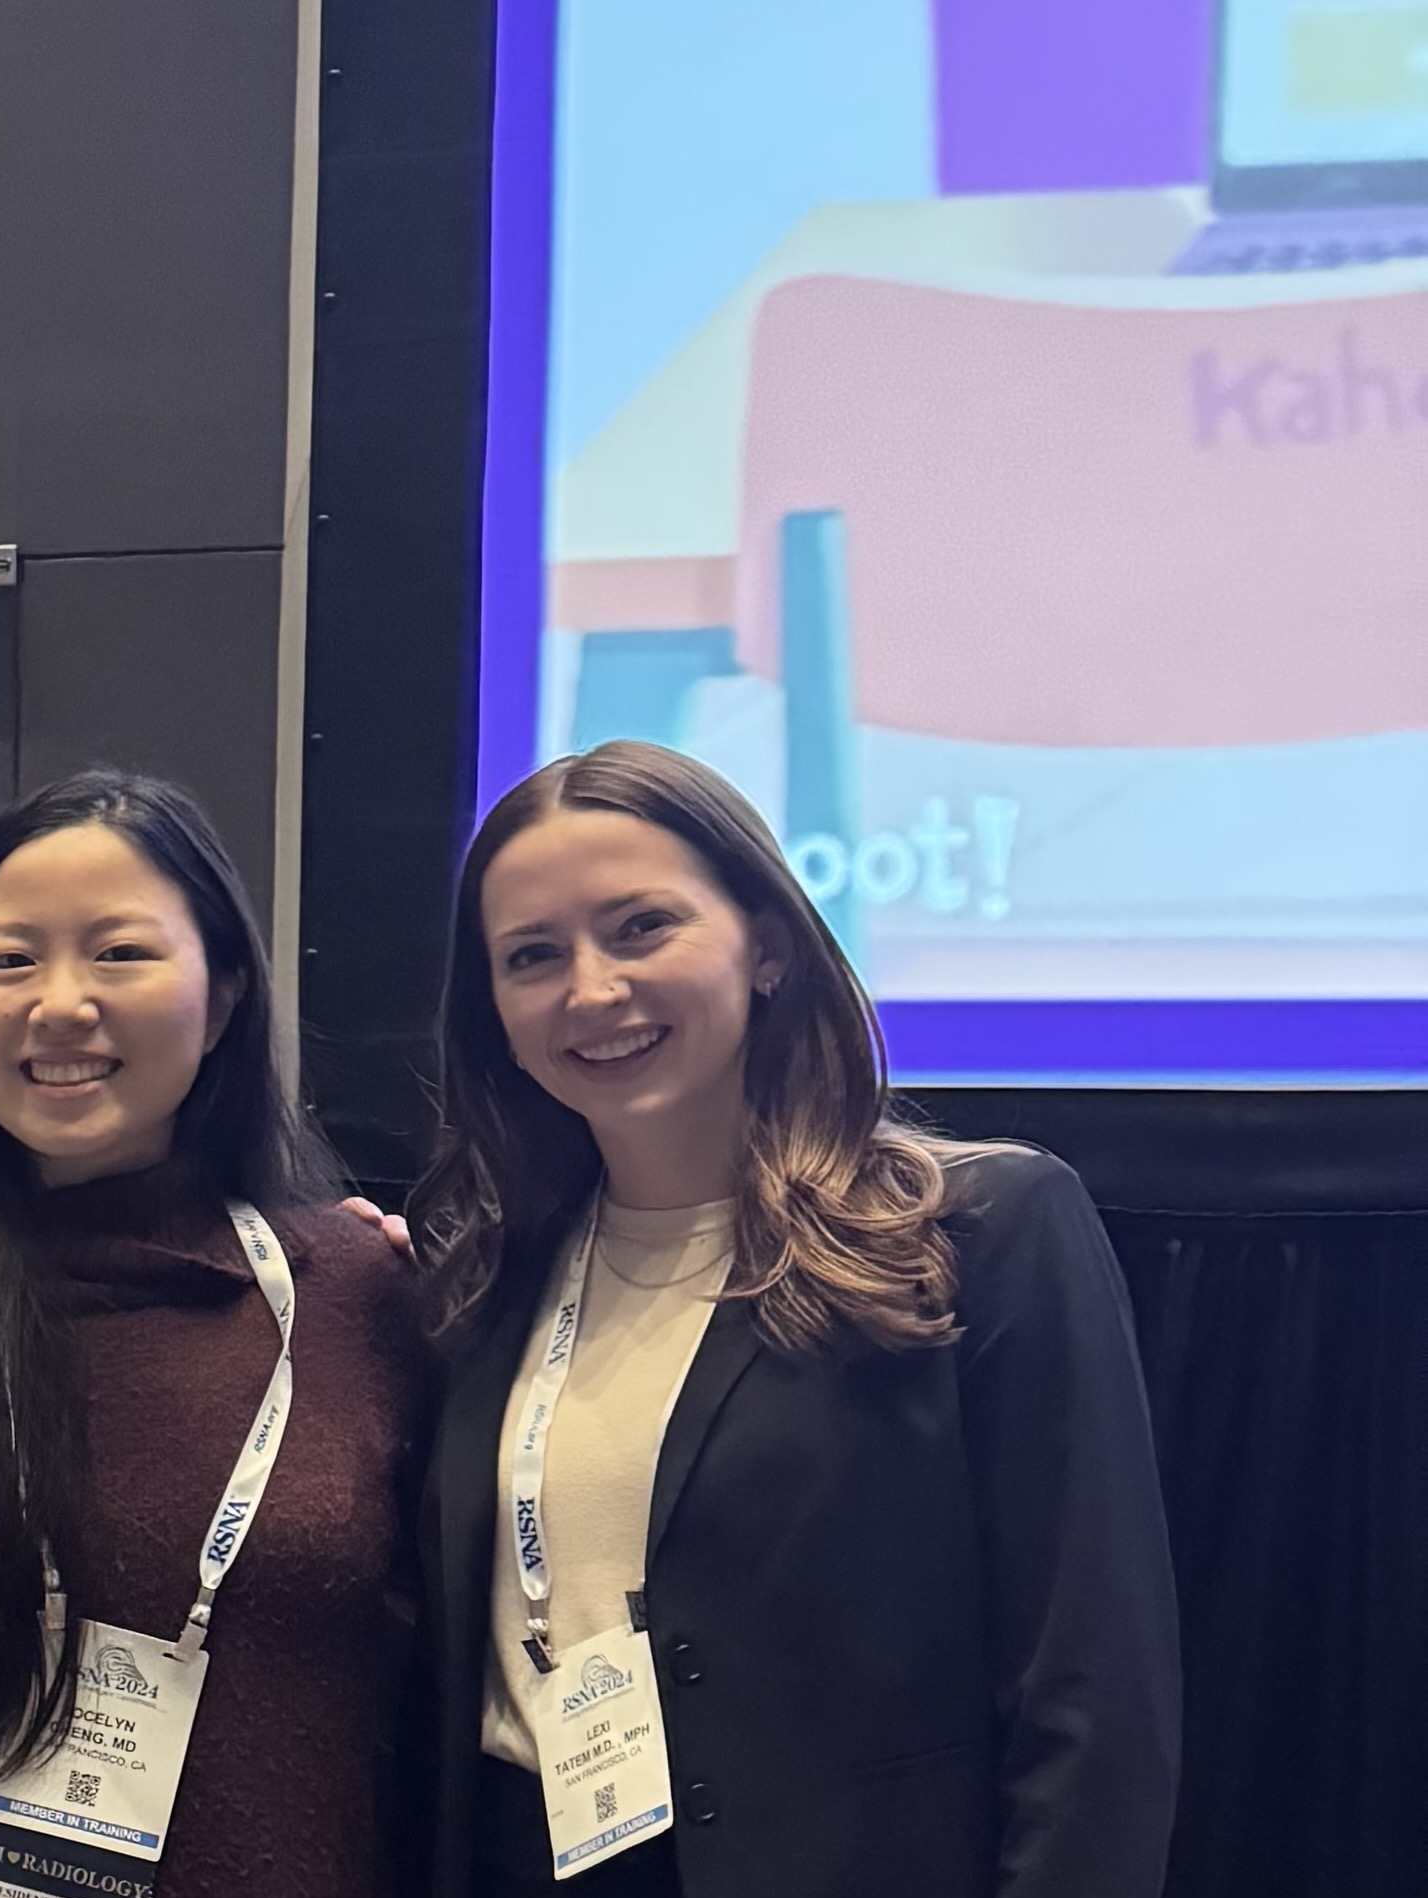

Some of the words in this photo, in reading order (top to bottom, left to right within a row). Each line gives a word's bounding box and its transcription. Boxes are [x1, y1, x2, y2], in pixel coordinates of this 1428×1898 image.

[784, 792, 1021, 920] oot!
[547, 1302, 576, 1366] RSNA
[252, 1404, 280, 1454] RSNA.org
[206, 1499, 251, 1564] RSNA
[517, 1496, 543, 1571] RSNA
[115, 1675, 160, 1700] 2024
[562, 1685, 598, 1714] RSNA
[600, 1669, 634, 1695] 2024
[73, 1706, 137, 1733] OCELYN
[586, 1719, 611, 1742] LEXI
[111, 1736, 138, 1753] MD
[130, 1760, 147, 1772] CA
[554, 1750, 592, 1776] TATEM
[623, 1722, 650, 1744] MPH
[565, 1774, 582, 1789] SAN
[628, 1744, 643, 1758] CA
[9, 1800, 65, 1824] MEMBER
[66, 1814, 81, 1828] IN
[82, 1818, 142, 1843] TRAINING
[615, 1810, 657, 1843] TRAINING
